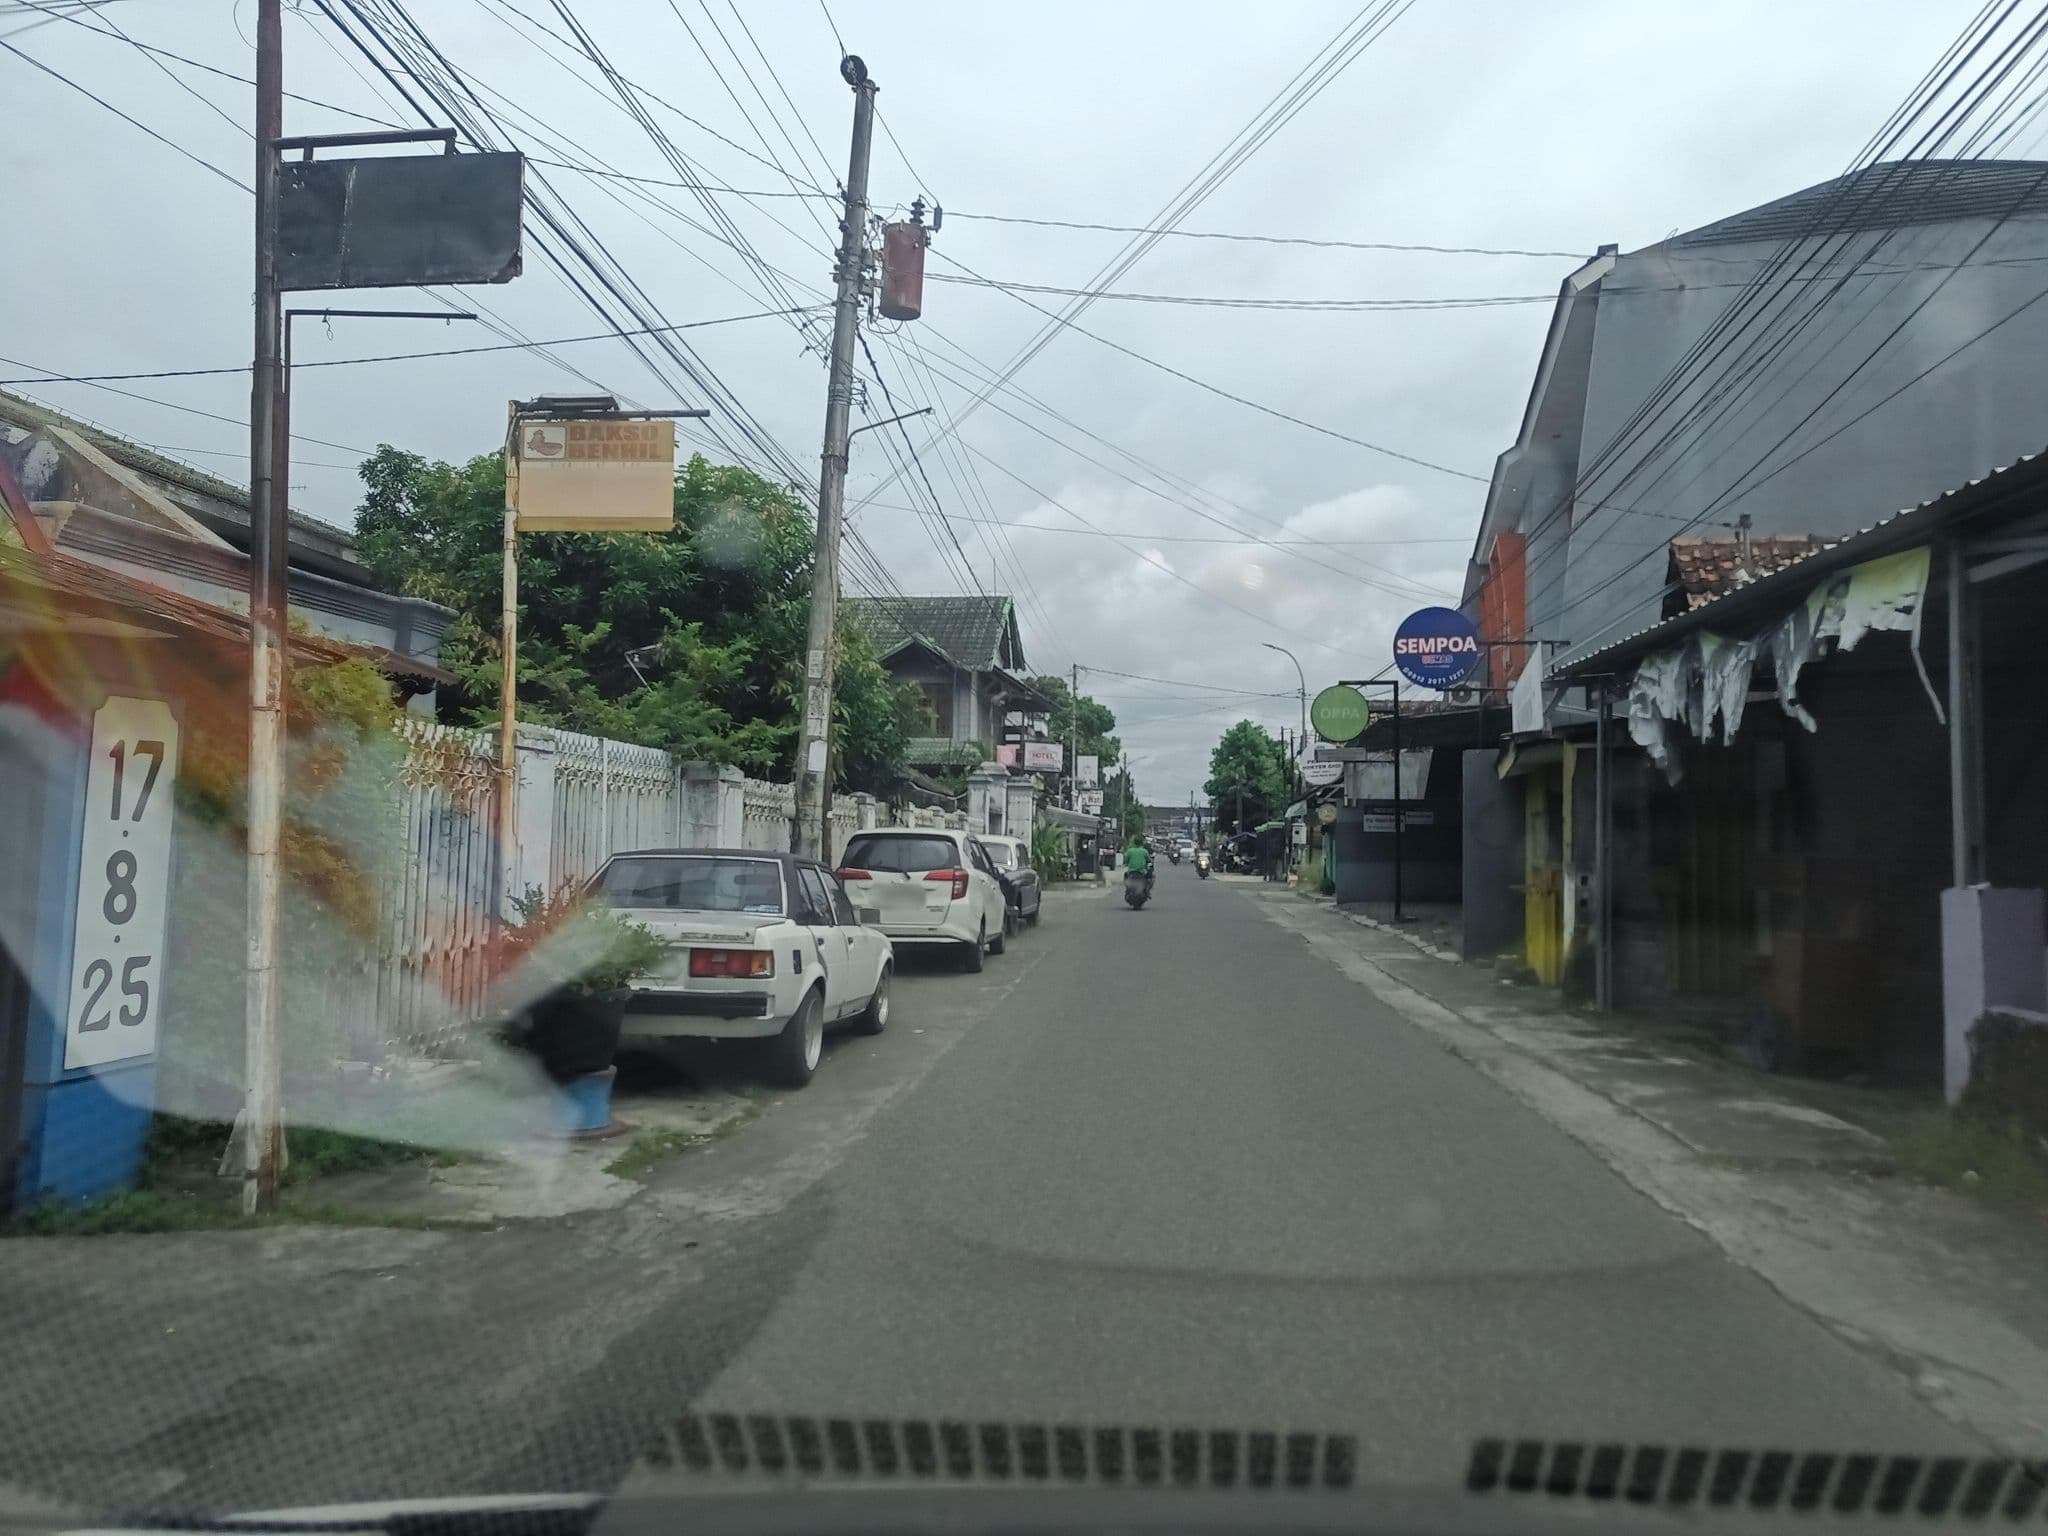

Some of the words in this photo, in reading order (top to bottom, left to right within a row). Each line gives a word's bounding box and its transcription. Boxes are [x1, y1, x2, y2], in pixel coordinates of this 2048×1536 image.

[569, 424, 658, 441] BAKSO
[1396, 636, 1477, 655] SEMPOA
[108, 738, 165, 822] 17
[103, 849, 138, 926] 8
[78, 955, 152, 1034] 25
